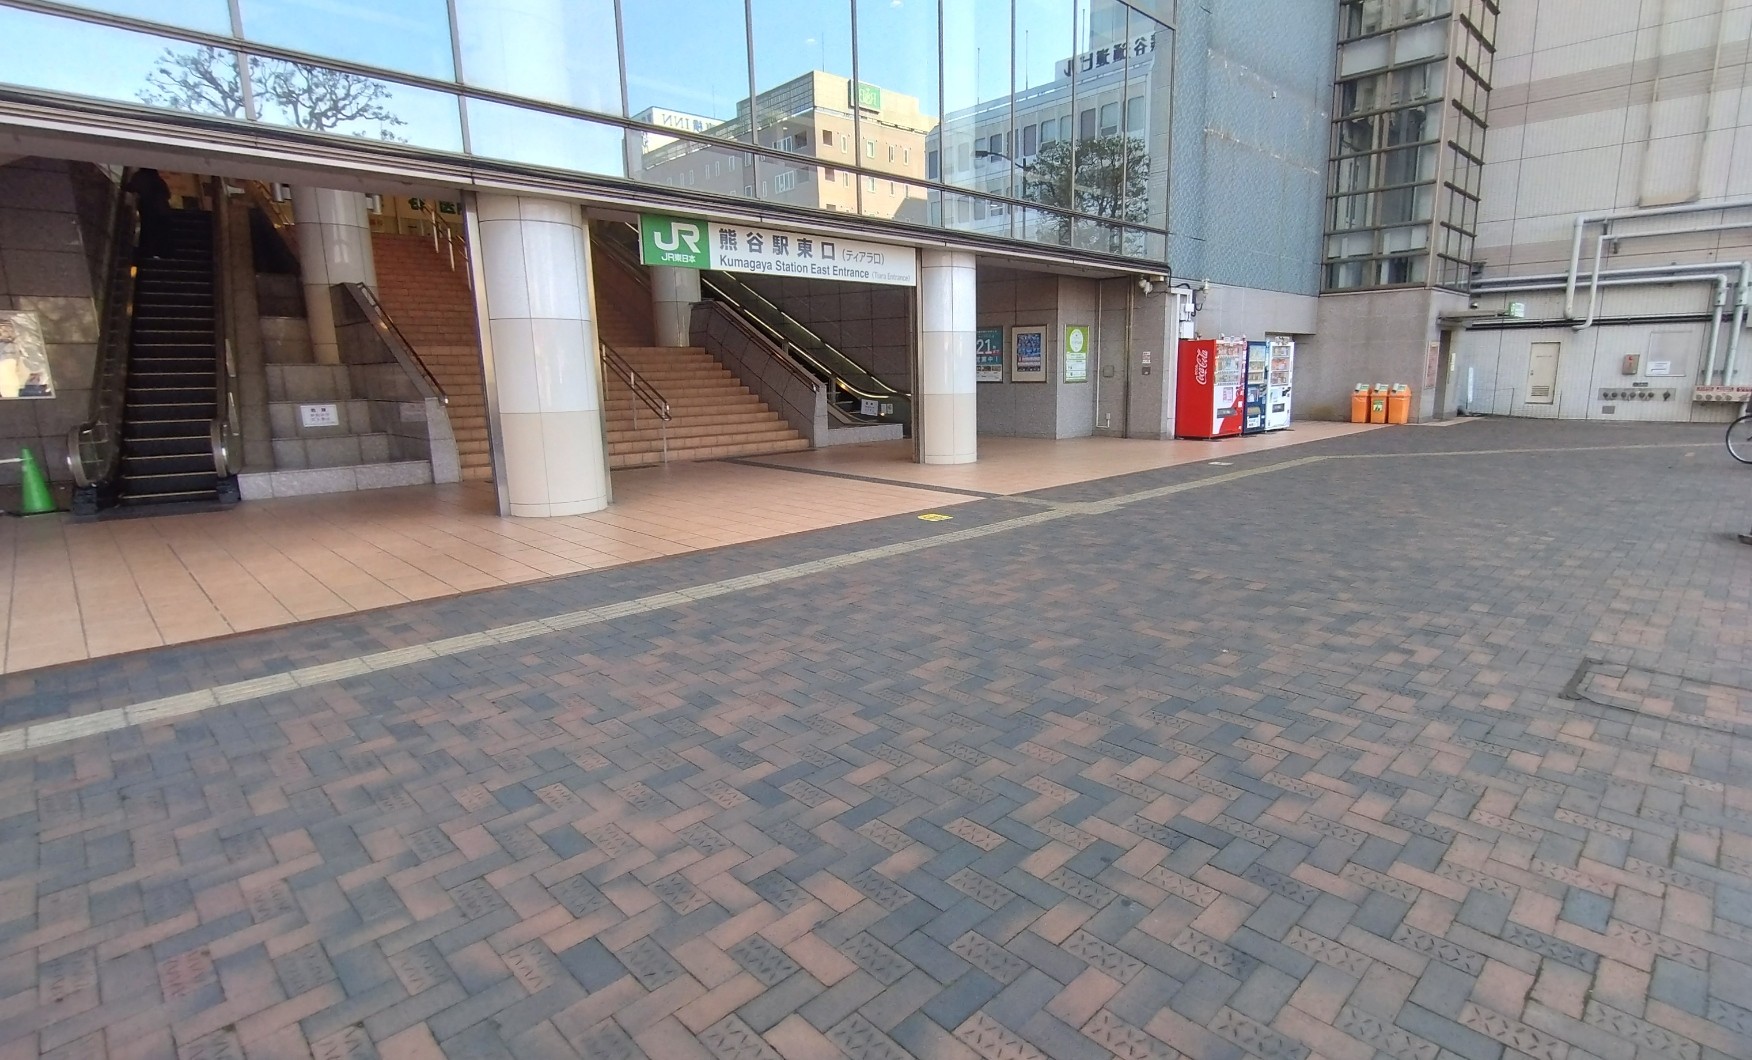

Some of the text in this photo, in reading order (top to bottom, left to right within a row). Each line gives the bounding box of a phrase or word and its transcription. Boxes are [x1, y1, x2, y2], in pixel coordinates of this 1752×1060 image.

[653, 222, 701, 254] JR
[718, 228, 836, 261] 熊谷駅東口
[661, 252, 696, 264] JR東日本
[720, 254, 773, 273] Kumagaya
[775, 260, 808, 275] Station
[810, 263, 831, 276] East
[832, 265, 870, 279] Entrance
[1195, 348, 1209, 385] Coca-Cola
